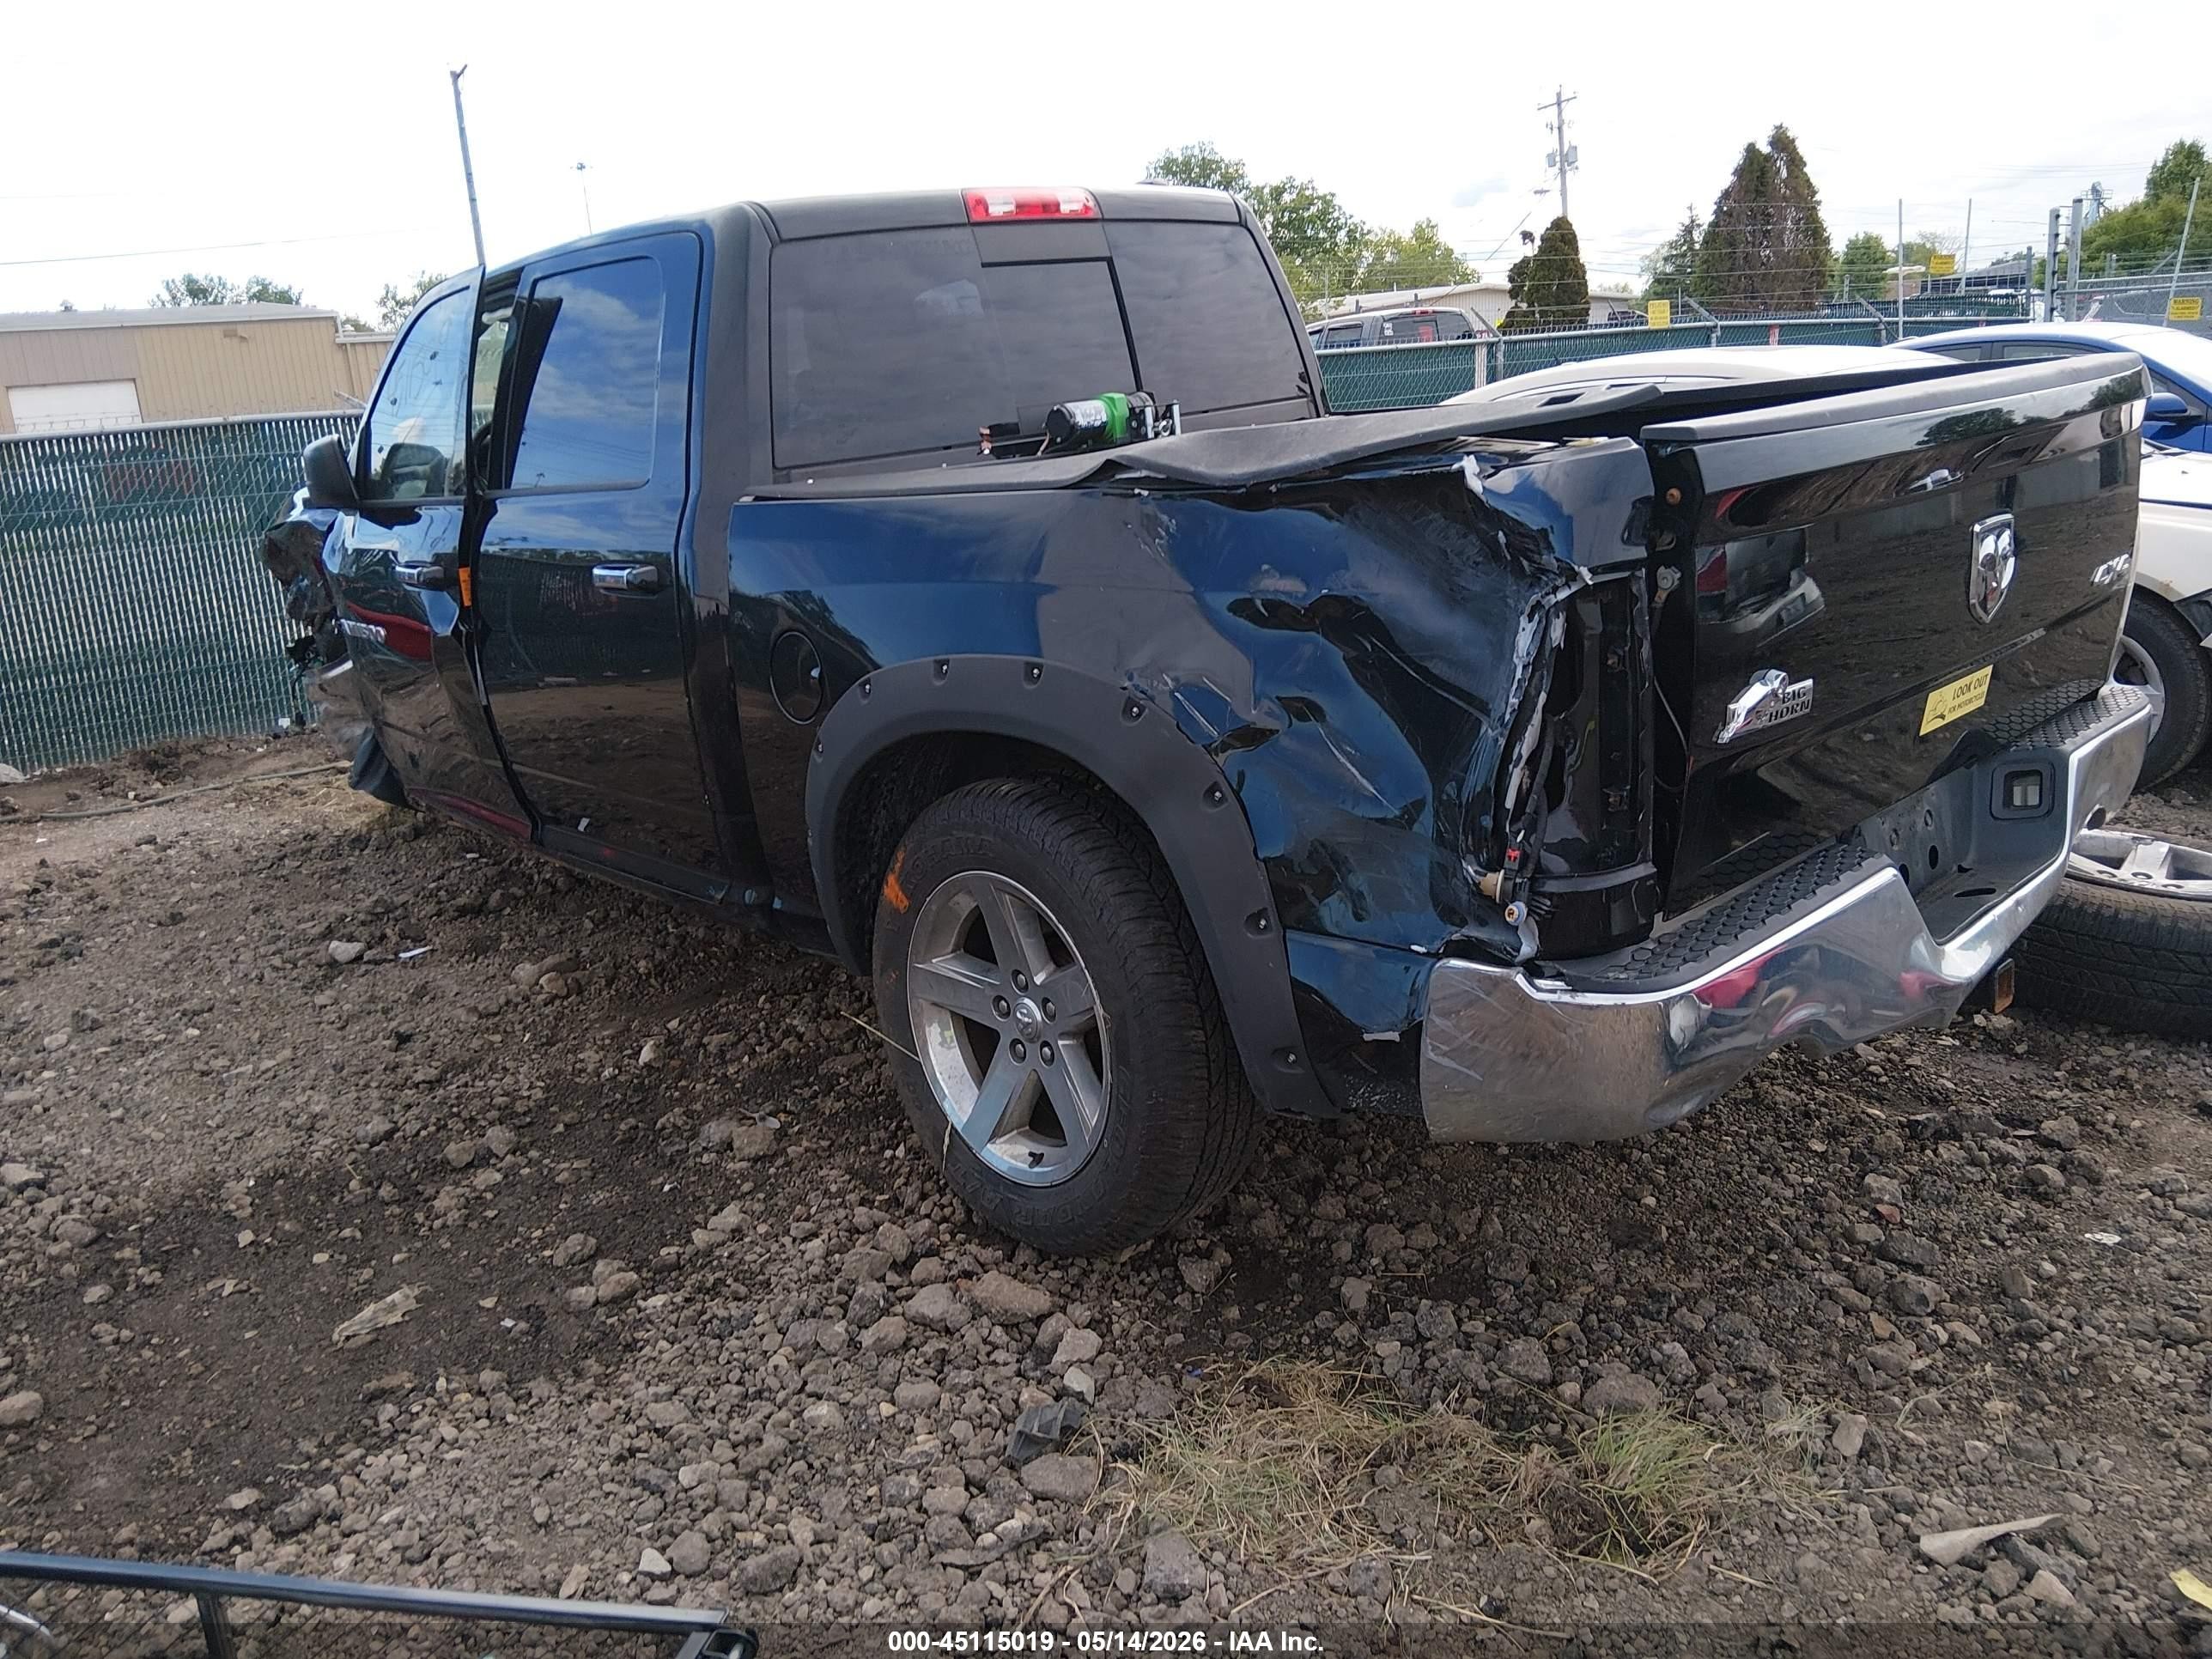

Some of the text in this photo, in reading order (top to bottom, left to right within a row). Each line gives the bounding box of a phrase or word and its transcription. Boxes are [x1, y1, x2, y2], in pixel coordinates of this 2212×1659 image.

[1782, 686, 1807, 704] BIG
[1952, 673, 1990, 702] LOOK OUT
[1768, 698, 1811, 723] HORN
[1948, 704, 1958, 715] FOR
